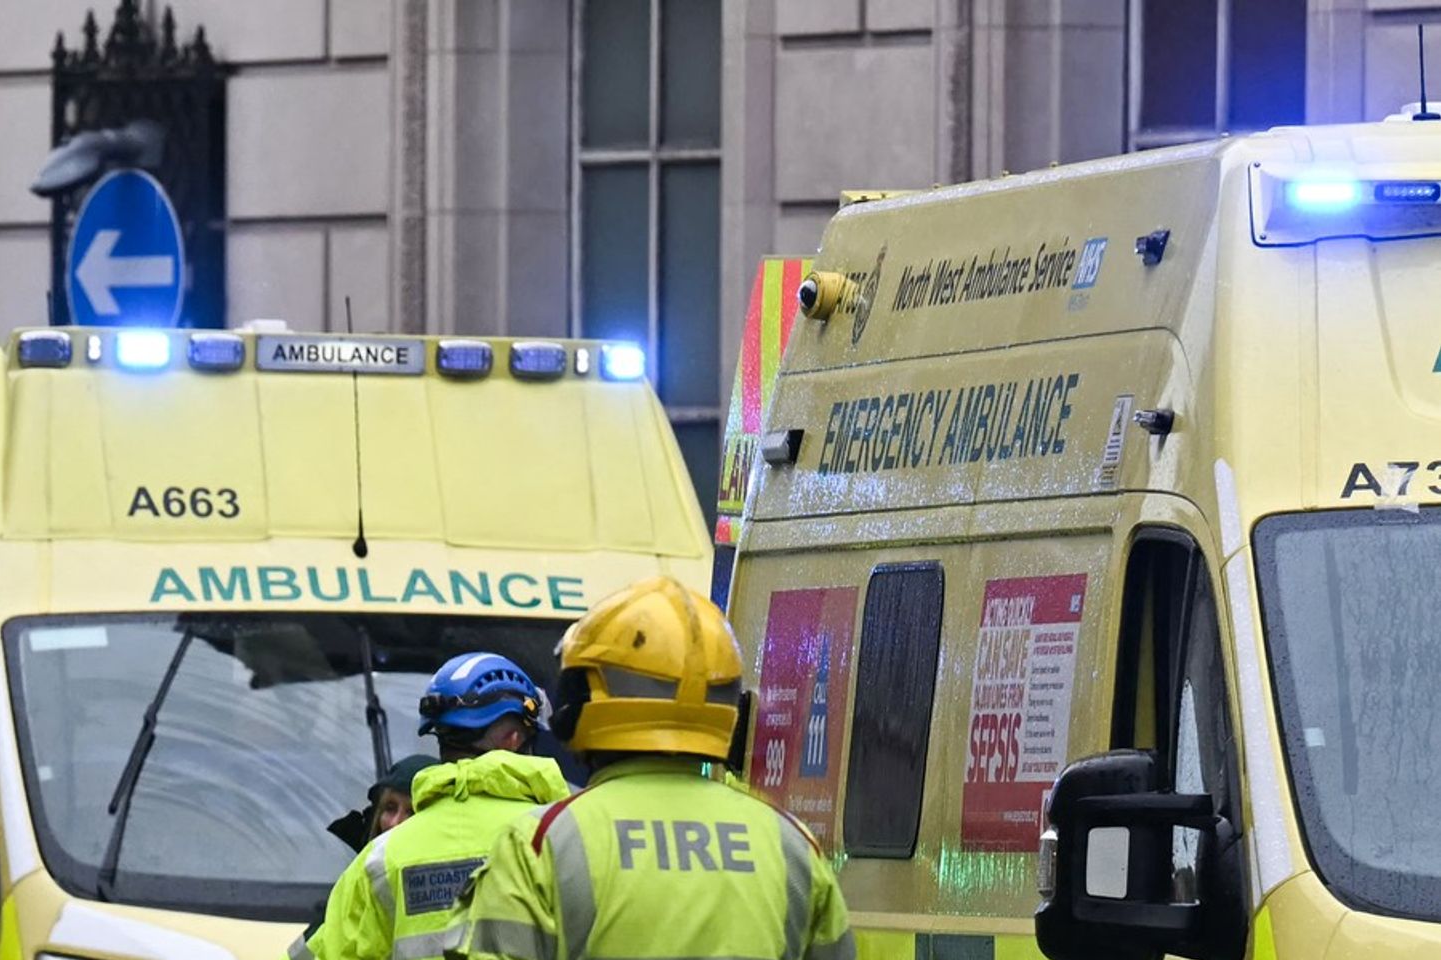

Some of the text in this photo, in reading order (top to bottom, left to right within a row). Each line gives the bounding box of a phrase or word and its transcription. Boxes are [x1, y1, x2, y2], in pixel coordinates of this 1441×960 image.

[891, 258, 933, 312] North
[927, 258, 966, 307] West
[959, 245, 1031, 302] Ambulance
[1028, 236, 1076, 292] Service
[1074, 240, 1107, 285] NHS
[272, 343, 409, 365] AMBULANCE
[818, 389, 951, 475] EMERGENCY
[938, 373, 1080, 465] AMBULANCE
[127, 486, 241, 519] A663
[149, 565, 589, 613] AMBULANCE
[764, 738, 786, 787] 999
[807, 714, 826, 765] 111
[967, 713, 1022, 783] SEPSIS
[614, 819, 756, 873] FIRE
[429, 868, 471, 886] COAST
